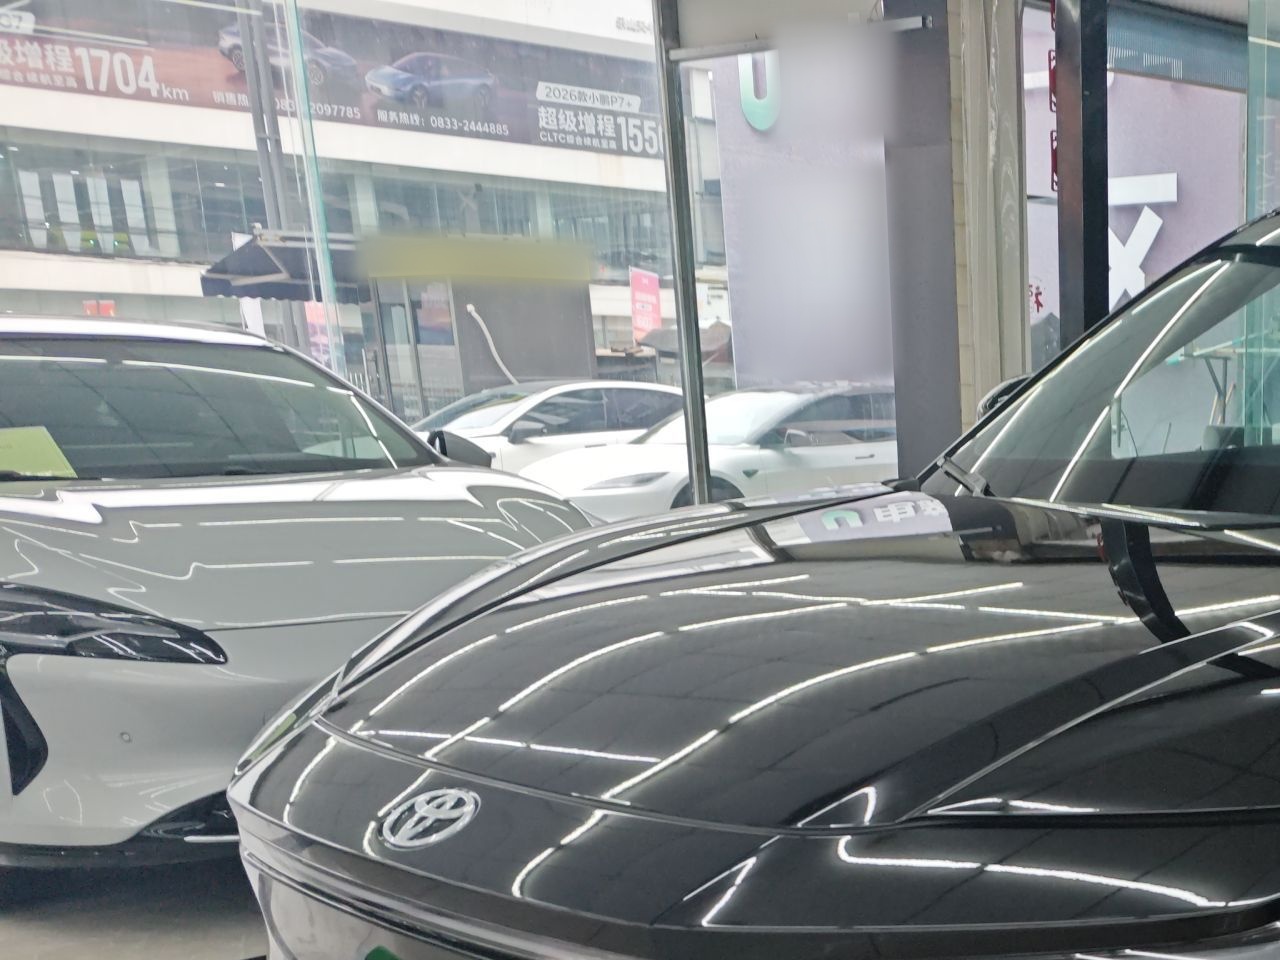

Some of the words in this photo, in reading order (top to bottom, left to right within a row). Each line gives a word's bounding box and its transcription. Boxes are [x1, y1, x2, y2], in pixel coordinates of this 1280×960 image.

[430, 115, 509, 136] 0833-2444885
[538, 105, 616, 138] 超级增程
[616, 116, 664, 155] 155
